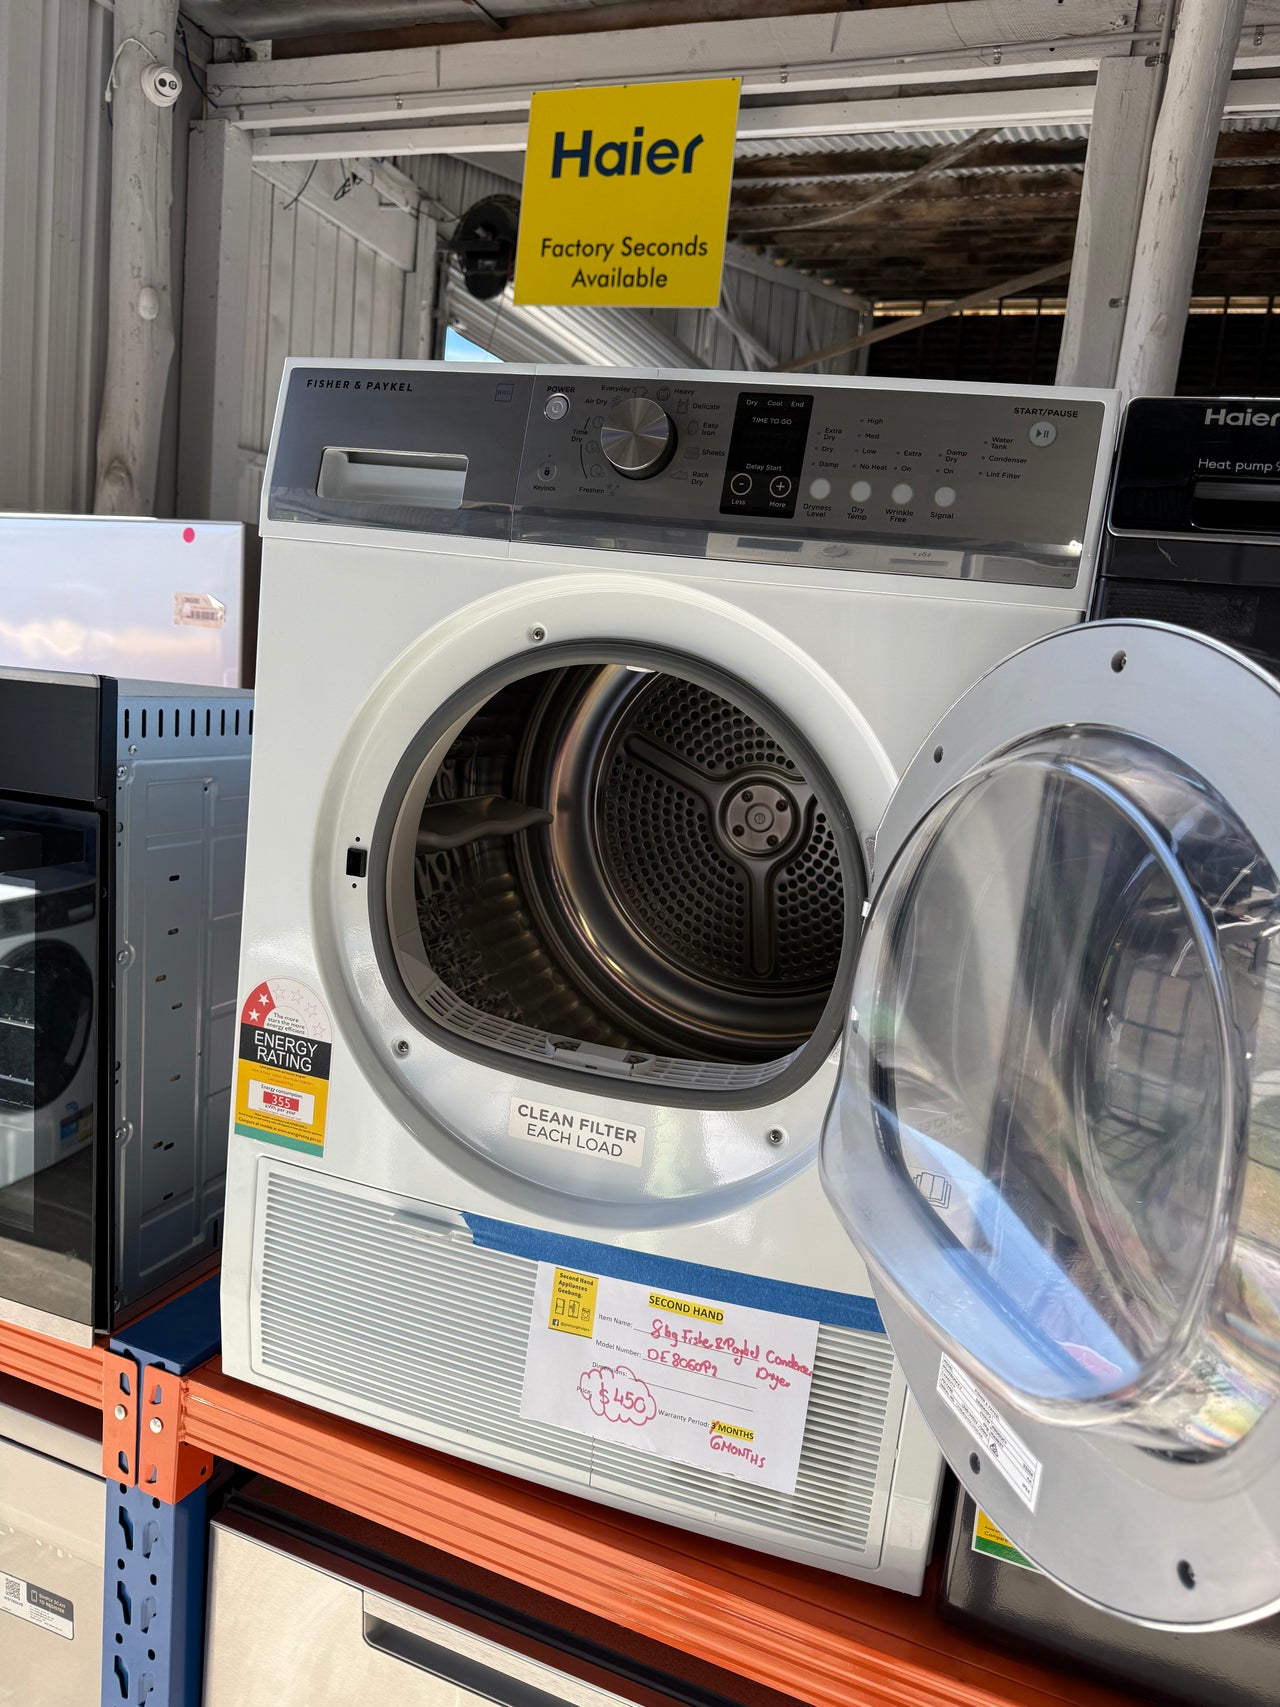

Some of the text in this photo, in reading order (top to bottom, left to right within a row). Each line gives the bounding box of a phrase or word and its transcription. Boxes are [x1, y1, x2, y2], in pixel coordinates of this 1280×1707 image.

[551, 126, 704, 179] Haier
[541, 235, 708, 262] Factory Seconds
[571, 267, 668, 288] Available
[306, 379, 413, 392] FISHER & PAYKEL
[601, 385, 631, 393] Everyday
[674, 388, 695, 396] Heavy
[1014, 407, 1079, 418] START/PAUSE
[1204, 408, 1280, 427] Haier
[703, 422, 719, 430] Easy
[702, 449, 725, 457] Sheets
[946, 450, 967, 458] Damp
[819, 461, 839, 469] Damp
[988, 455, 1028, 464] Condenser
[746, 463, 764, 471] Delay
[1198, 458, 1231, 470] Heat
[1235, 462, 1273, 474] pump
[1002, 472, 1021, 480] Filter
[803, 503, 832, 512] Dryness
[885, 508, 914, 517] Wrinkle
[847, 513, 867, 521] Temp
[930, 511, 954, 520] Signal
[274, 1012, 283, 1020] The
[266, 1022, 284, 1031] energy
[254, 1030, 318, 1057] ENERGY
[257, 1046, 312, 1072] RATING
[261, 1083, 303, 1099] Energy consumption
[271, 1094, 291, 1109] 355
[517, 1104, 637, 1143] CLEAN FILTER
[527, 1123, 623, 1157] EACH LOAD
[559, 1272, 594, 1286] Second Hand
[558, 1280, 588, 1292] Appliances
[648, 1295, 724, 1321] SECOND HAND
[598, 1313, 633, 1328] Item Name:
[595, 1339, 642, 1358] Model Number:
[658, 1409, 687, 1423] Warranty
[687, 1417, 710, 1428] Period:
[717, 1424, 754, 1440] MONTHS
